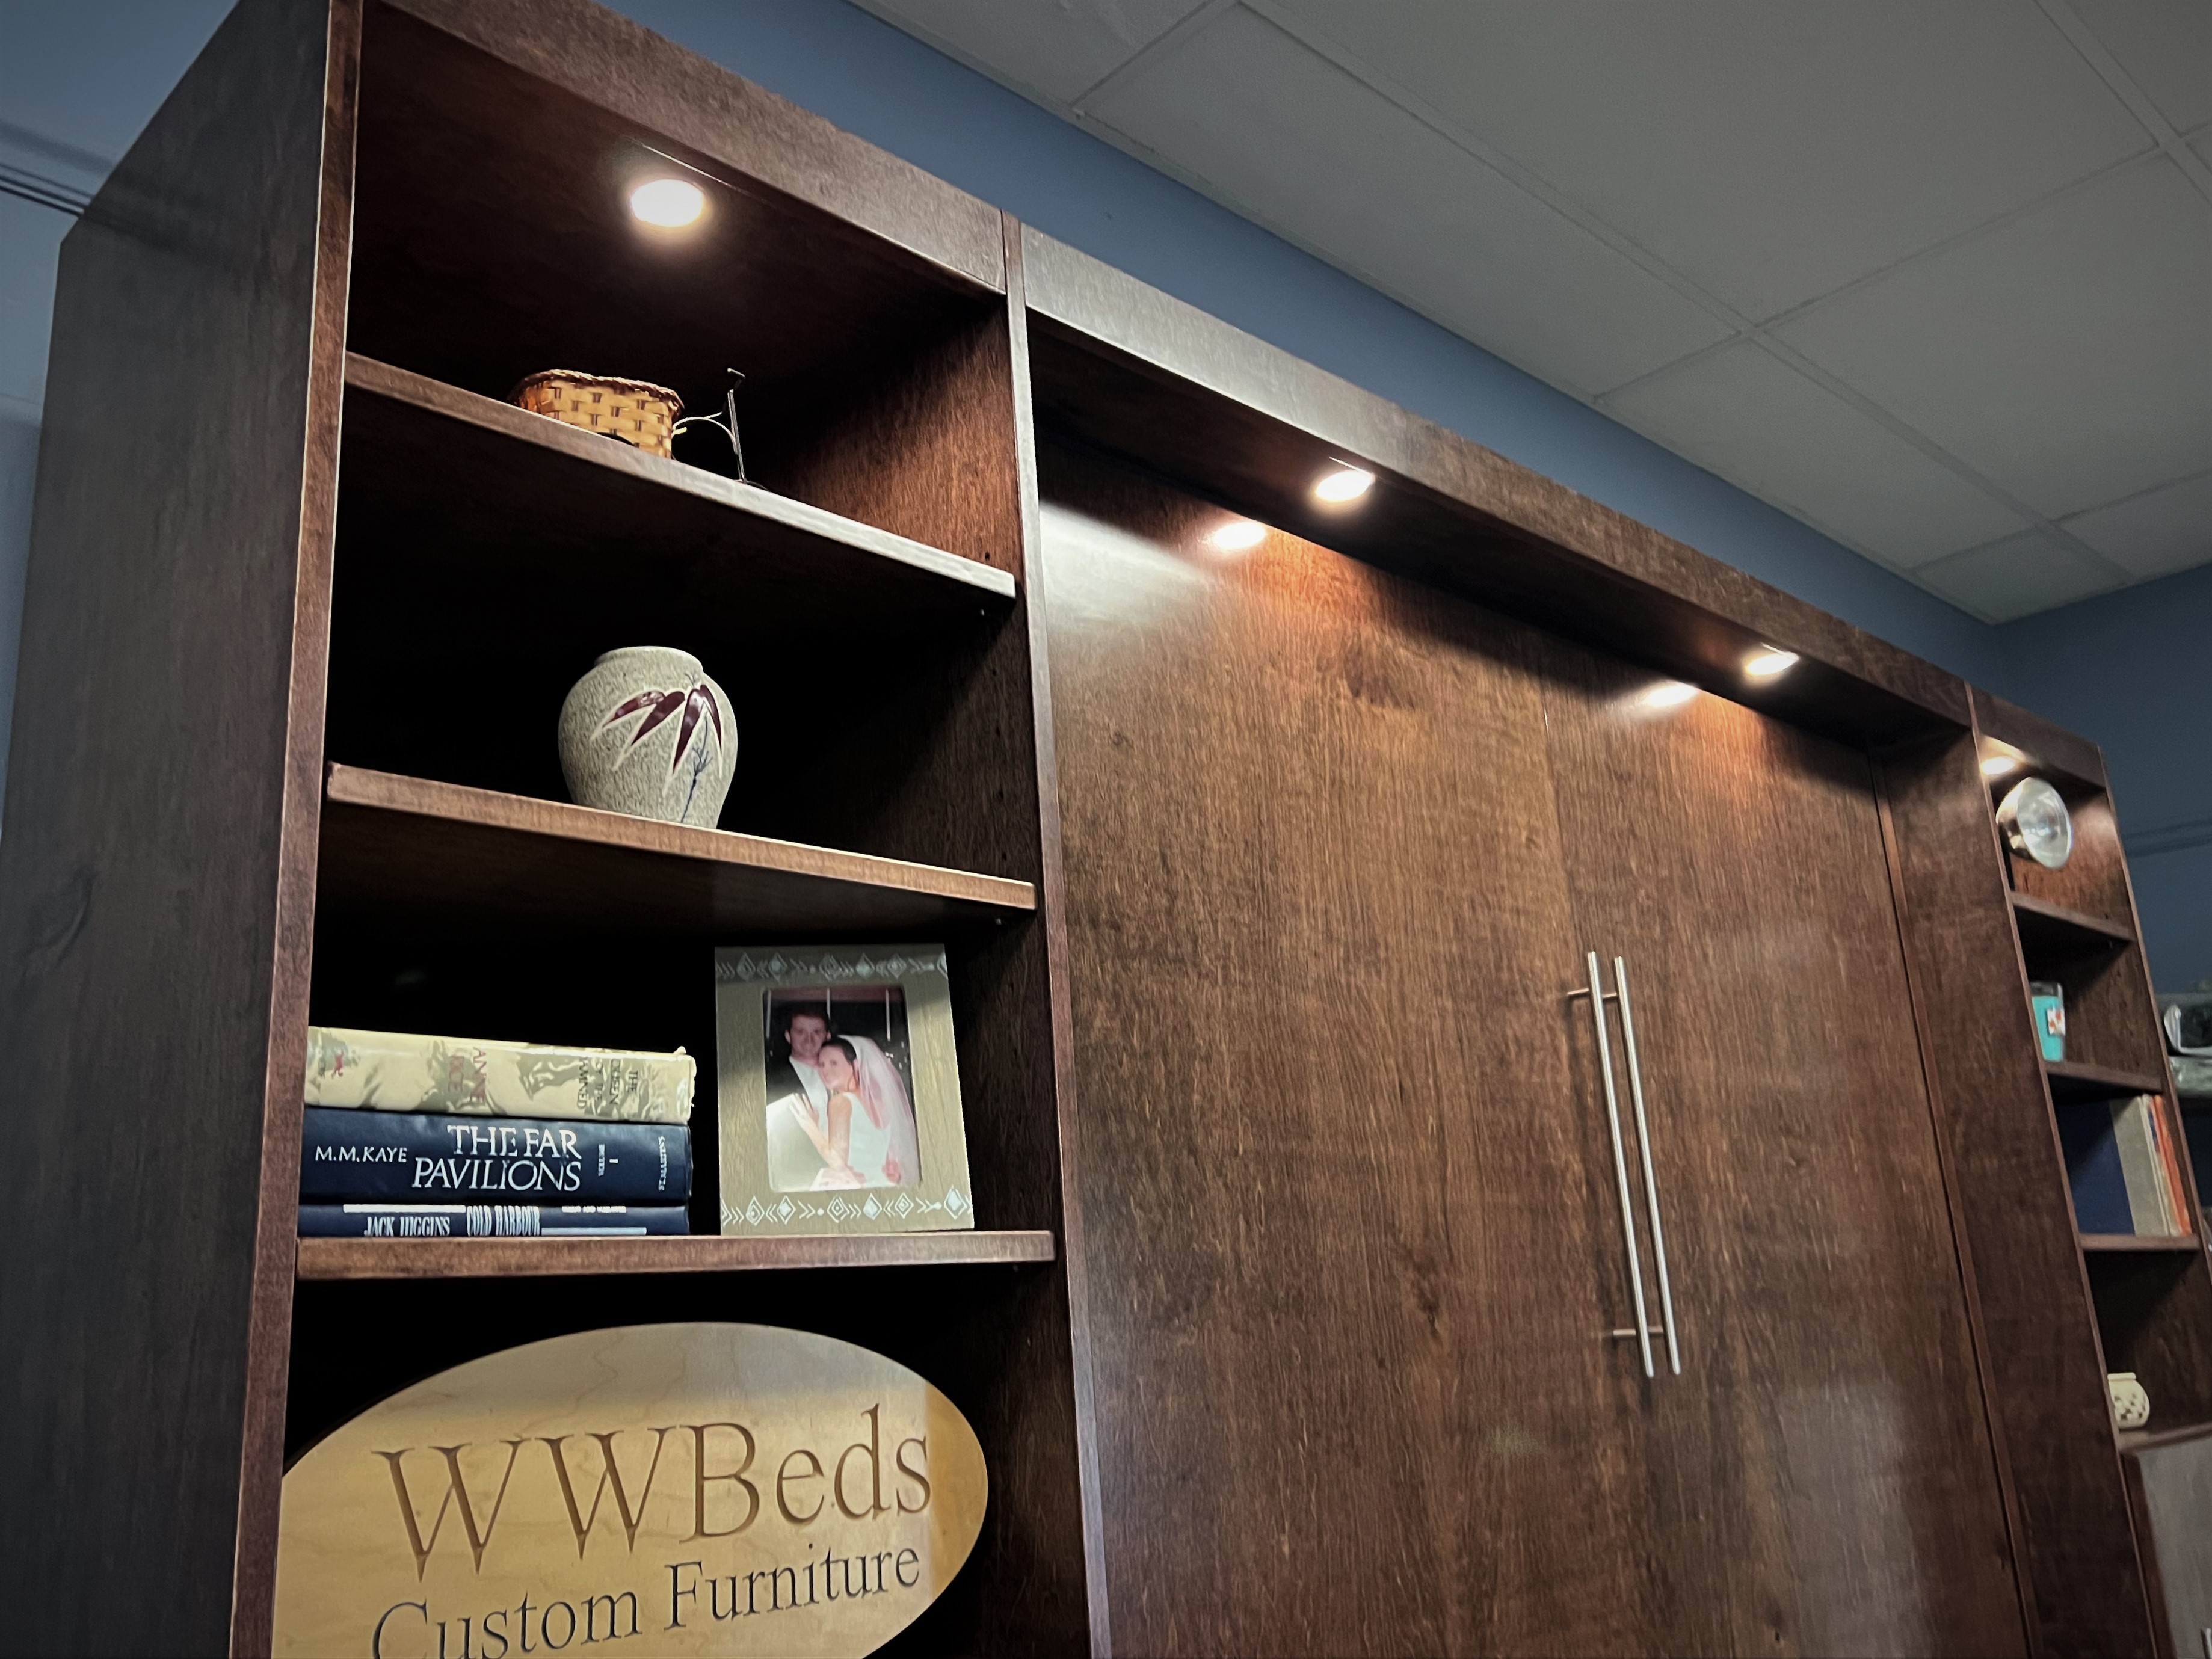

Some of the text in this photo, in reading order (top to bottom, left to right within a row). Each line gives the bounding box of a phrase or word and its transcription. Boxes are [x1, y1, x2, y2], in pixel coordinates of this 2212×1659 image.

[628, 1070, 638, 1094] THE
[315, 1145, 407, 1163] M.M.KAYE
[447, 1125, 581, 1159] THE FAR
[411, 1157, 581, 1191] PAVILIONS
[363, 1216, 450, 1237] JACK HIGGINS
[494, 1205, 540, 1236] HARBOUR
[372, 1542, 921, 1659] Custom Furniture
